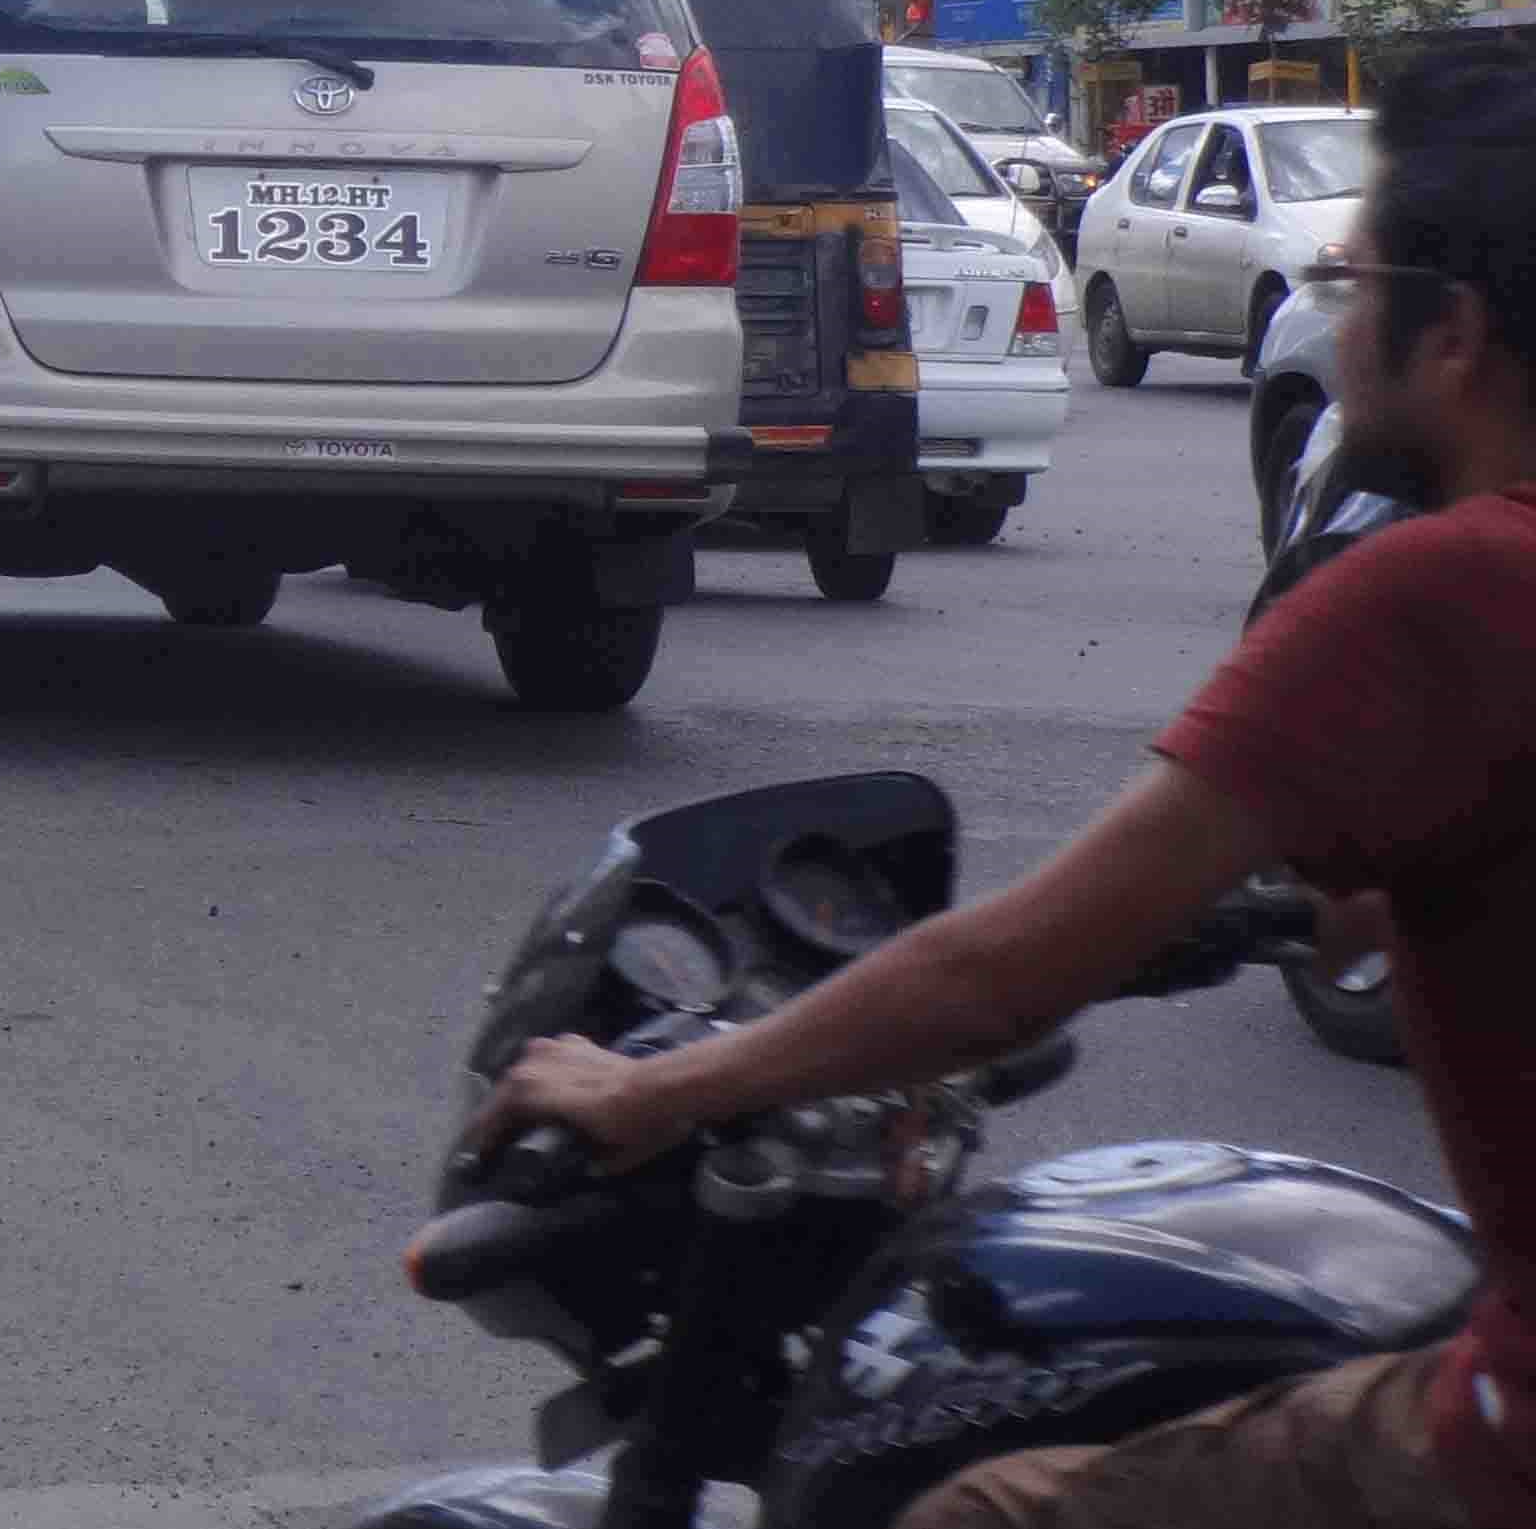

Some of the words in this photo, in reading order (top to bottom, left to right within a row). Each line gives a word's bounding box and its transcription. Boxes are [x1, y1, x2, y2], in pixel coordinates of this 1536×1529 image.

[583, 72, 615, 86] DSK
[618, 72, 673, 87] TOYOTA
[202, 139, 457, 157] INNOVA
[208, 207, 430, 265] 1234
[315, 439, 393, 457] TOYOTA
